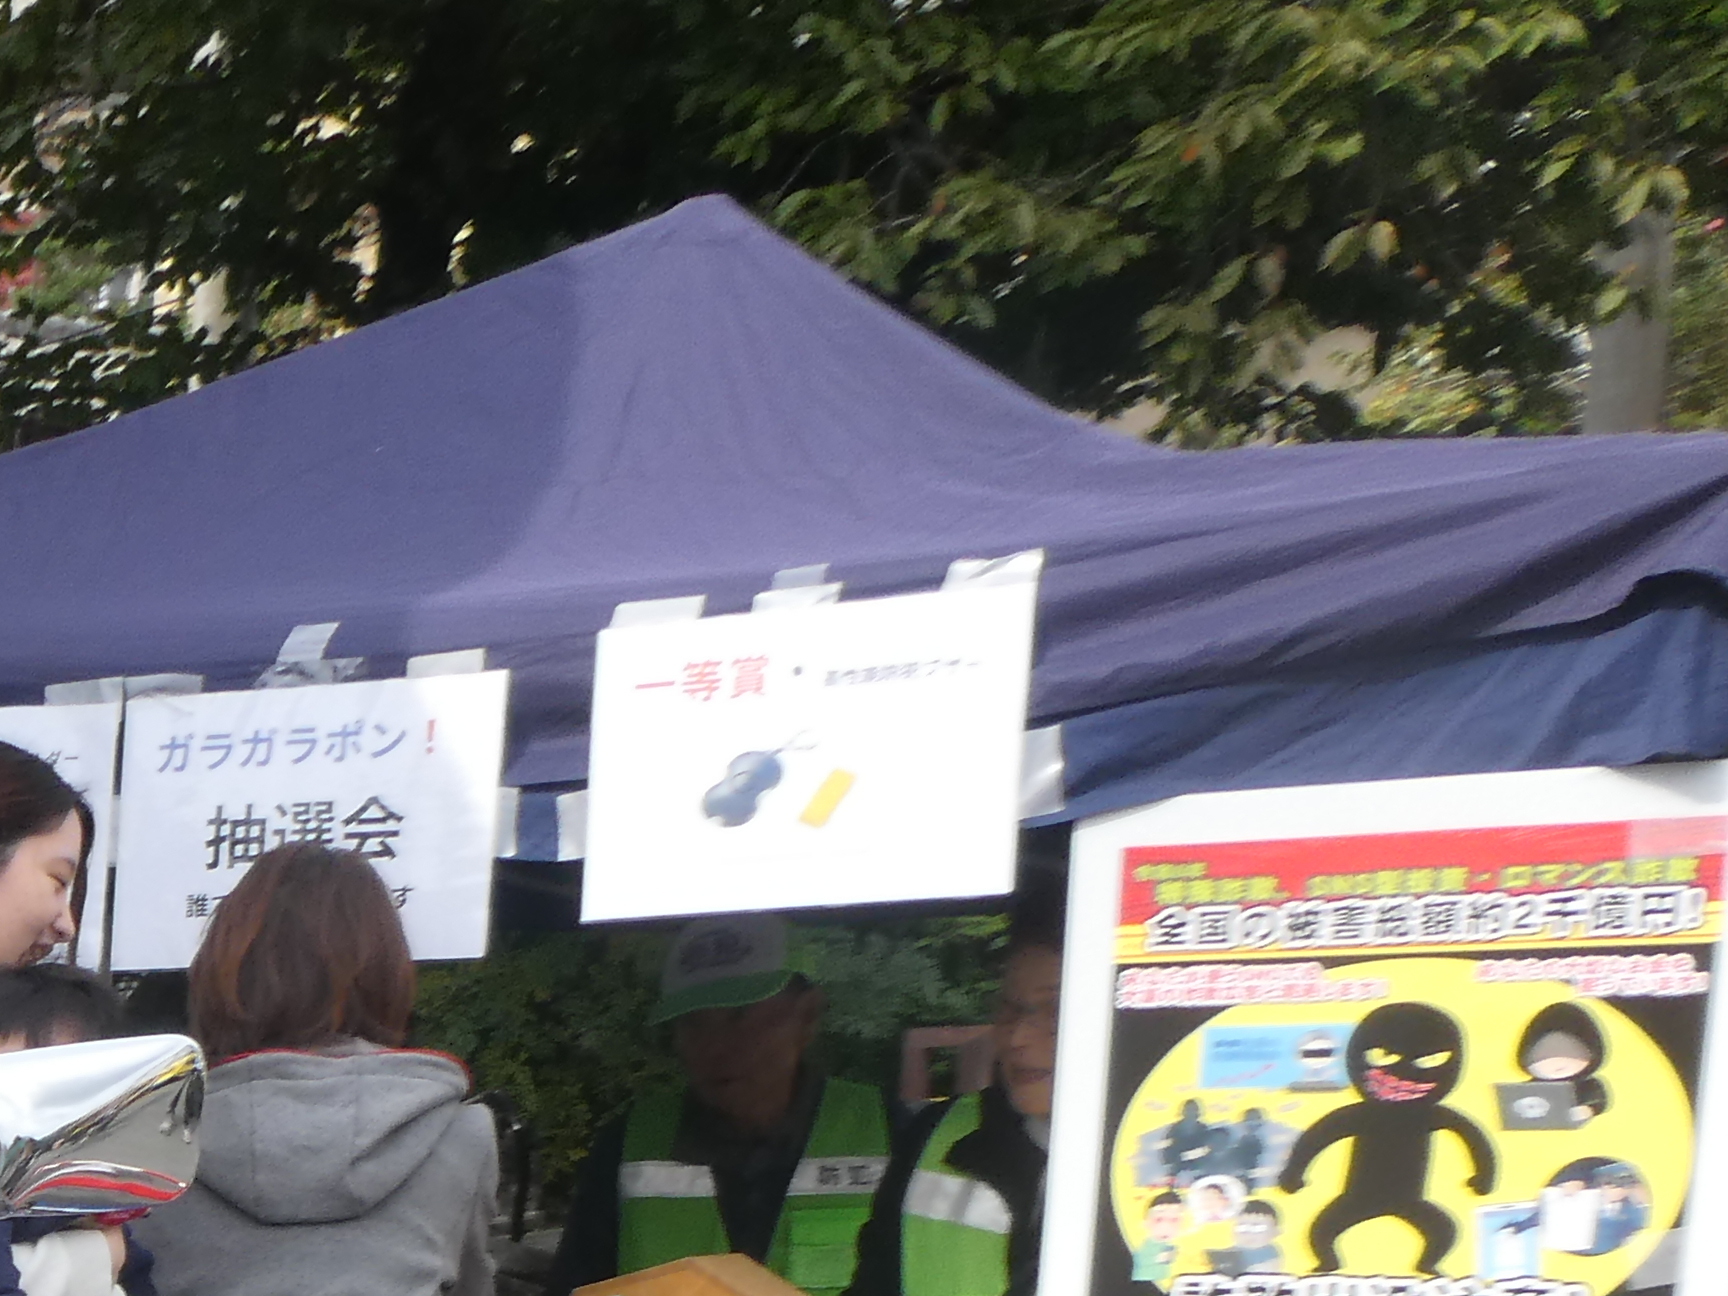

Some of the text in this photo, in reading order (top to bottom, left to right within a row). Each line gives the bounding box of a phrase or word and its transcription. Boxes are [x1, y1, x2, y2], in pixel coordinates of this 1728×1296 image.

[156, 718, 439, 774] ガラガラポン！
[203, 794, 405, 872] 抽選会
[185, 892, 230, 919] 誰
